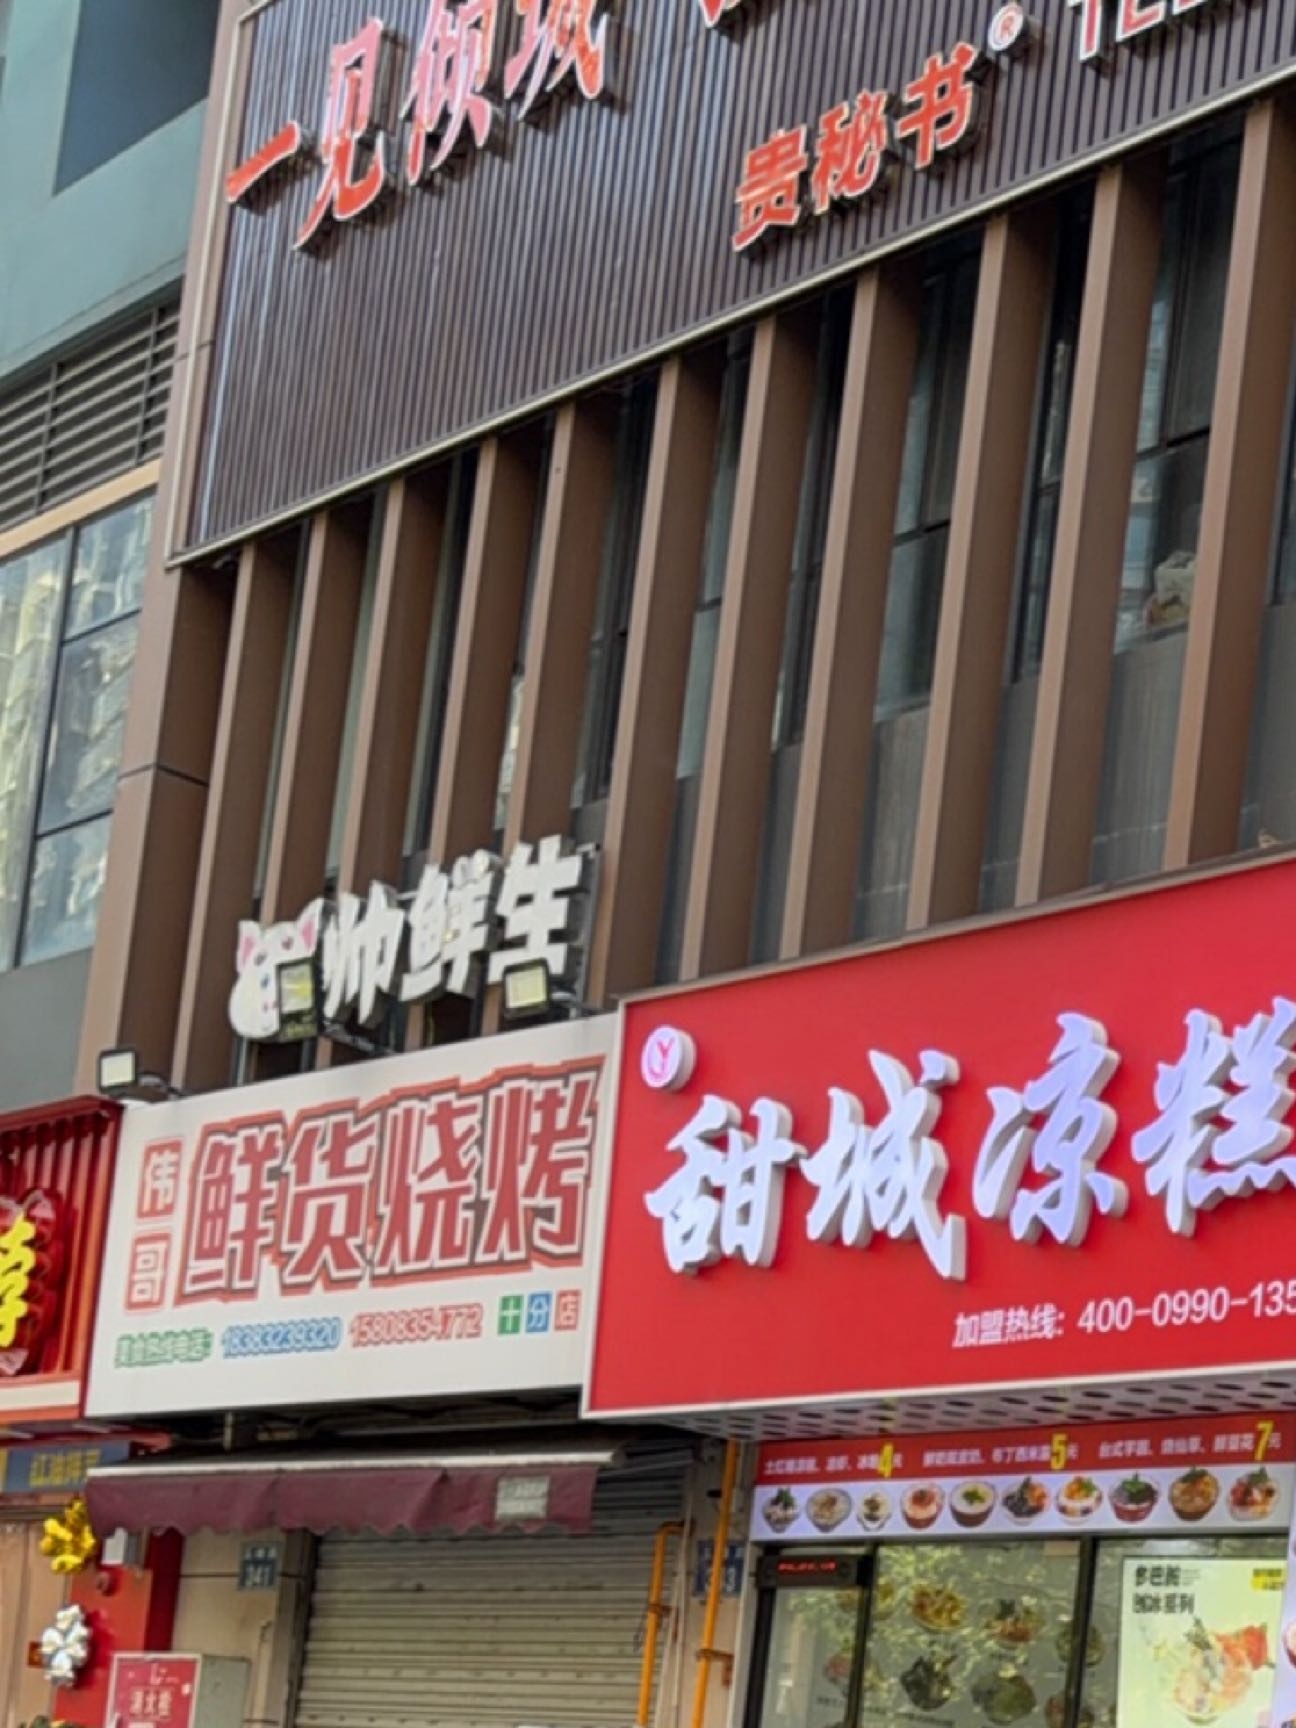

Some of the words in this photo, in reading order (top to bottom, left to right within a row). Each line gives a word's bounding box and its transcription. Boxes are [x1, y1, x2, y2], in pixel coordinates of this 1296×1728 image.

[226, 0, 602, 250] 一见倾城
[733, 42, 980, 253] 贵秘书
[182, 1060, 603, 1302] 鲜货烧烤
